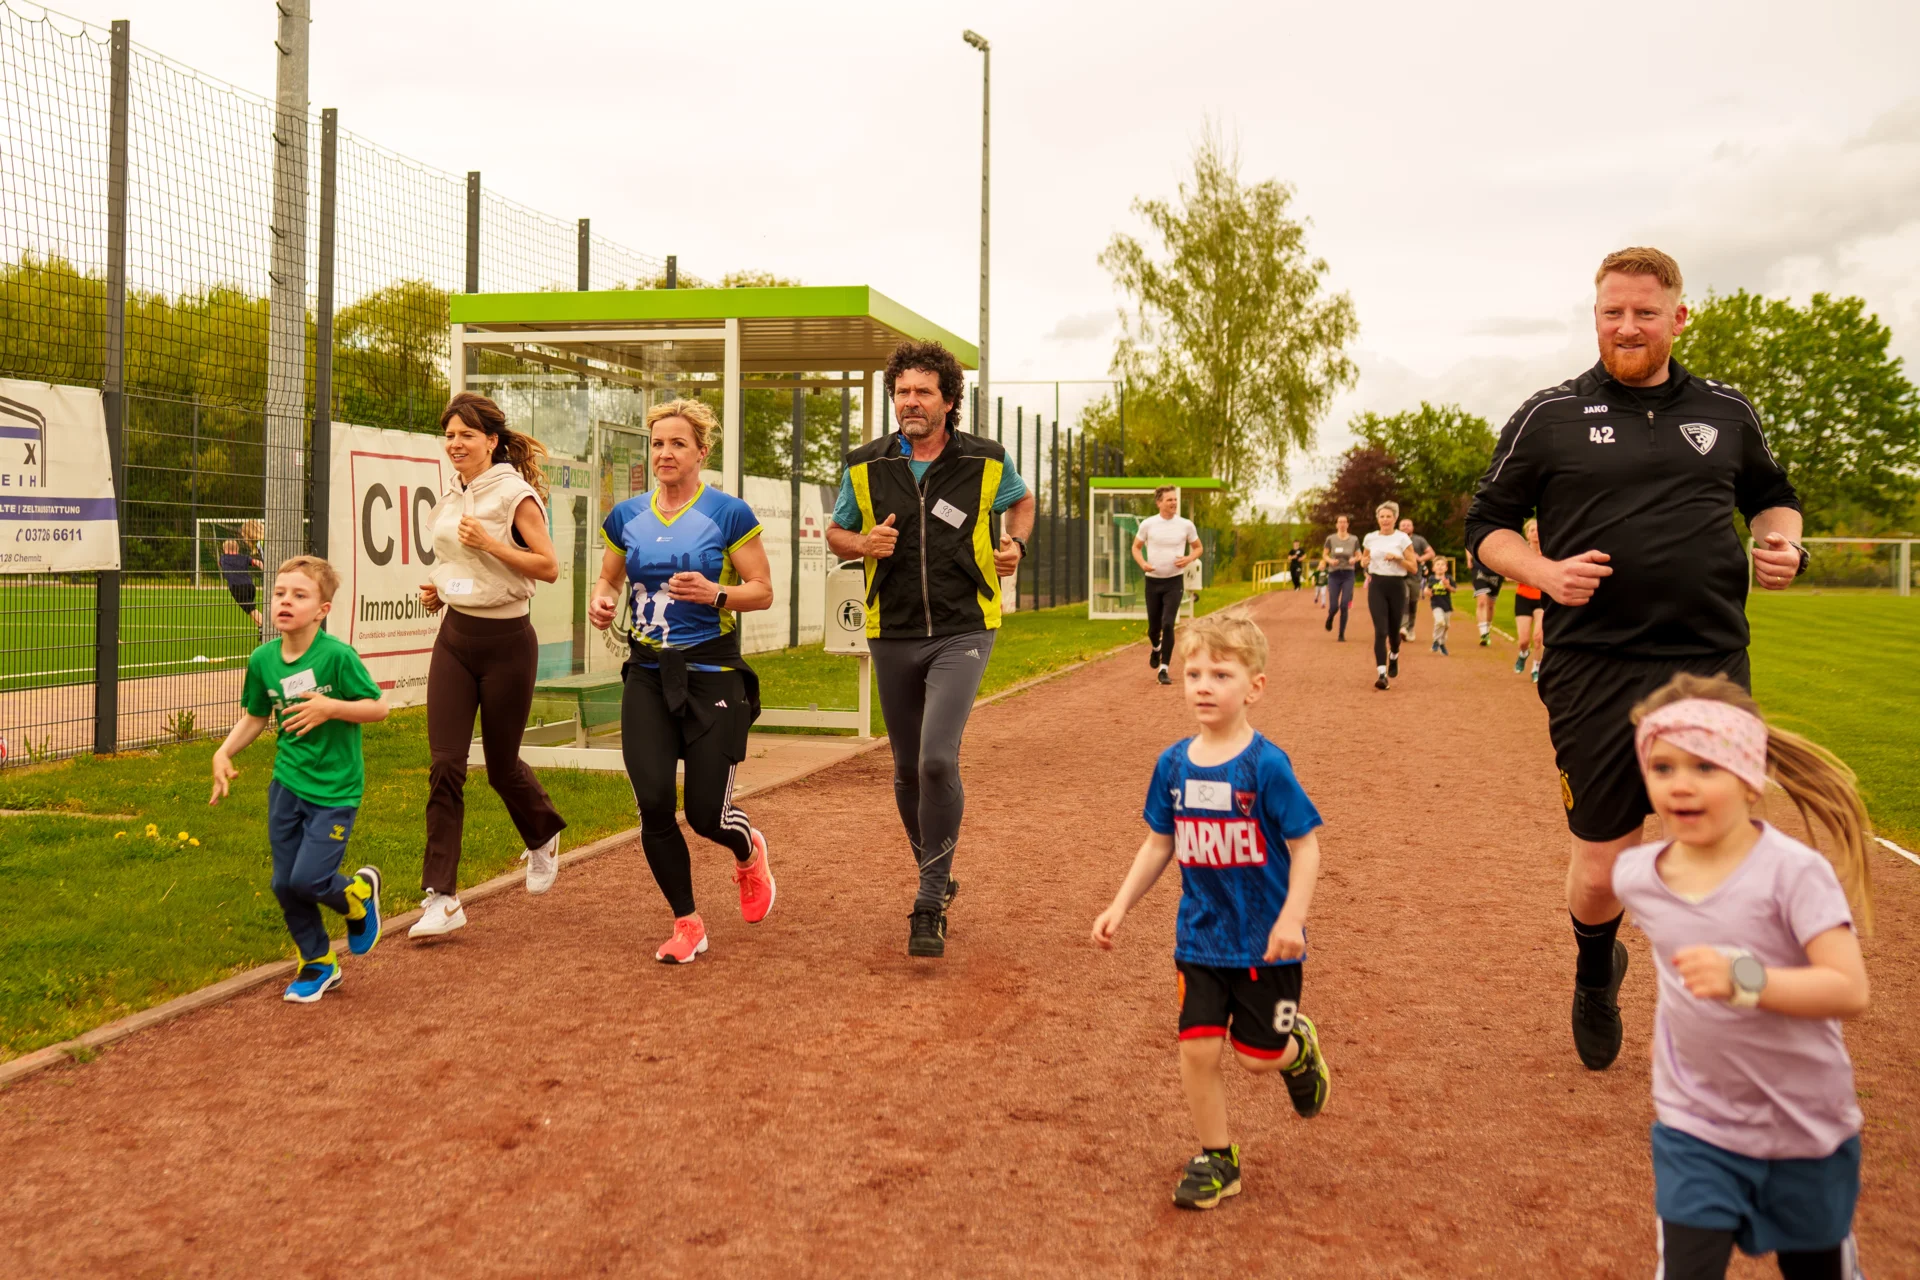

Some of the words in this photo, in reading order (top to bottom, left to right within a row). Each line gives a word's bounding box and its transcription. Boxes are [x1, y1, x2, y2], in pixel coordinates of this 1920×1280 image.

[1583, 405, 1608, 414] JAKO
[1589, 426, 1616, 444] 42
[940, 505, 953, 518] 98
[25, 528, 50, 542] 03726
[53, 528, 82, 541] 6611
[361, 482, 437, 566] CIC
[360, 592, 439, 621] Immobili
[1175, 820, 1264, 865] MARVEL
[1273, 999, 1297, 1034] 8
